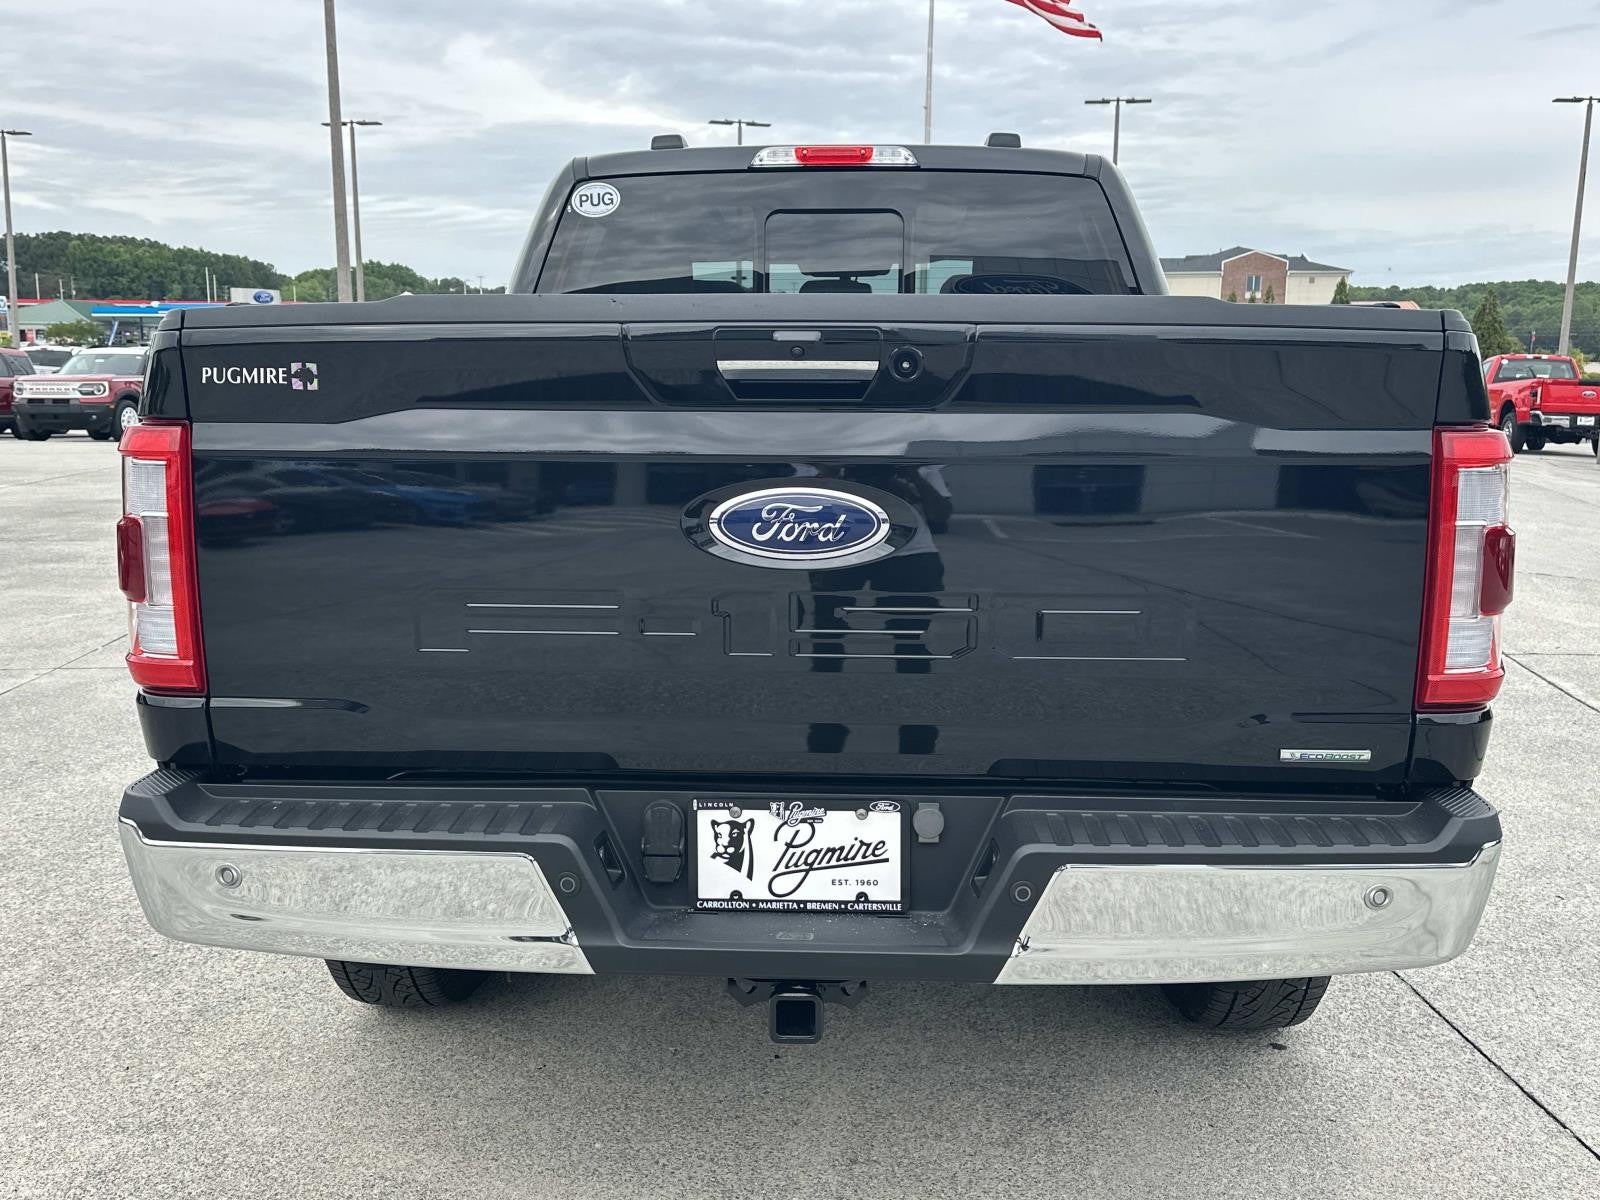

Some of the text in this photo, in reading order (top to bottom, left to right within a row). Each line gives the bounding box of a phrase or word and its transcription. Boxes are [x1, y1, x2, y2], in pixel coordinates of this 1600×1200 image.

[579, 192, 614, 207] PUG
[201, 366, 288, 384] PUGMIRE
[751, 503, 847, 542] Ford
[416, 588, 1197, 661] F-150
[768, 821, 890, 898] Pugmire
[855, 879, 879, 887] 1960
[696, 900, 902, 911] CARROLLTON MARIETTA BREMEN CARTERSVILLE
